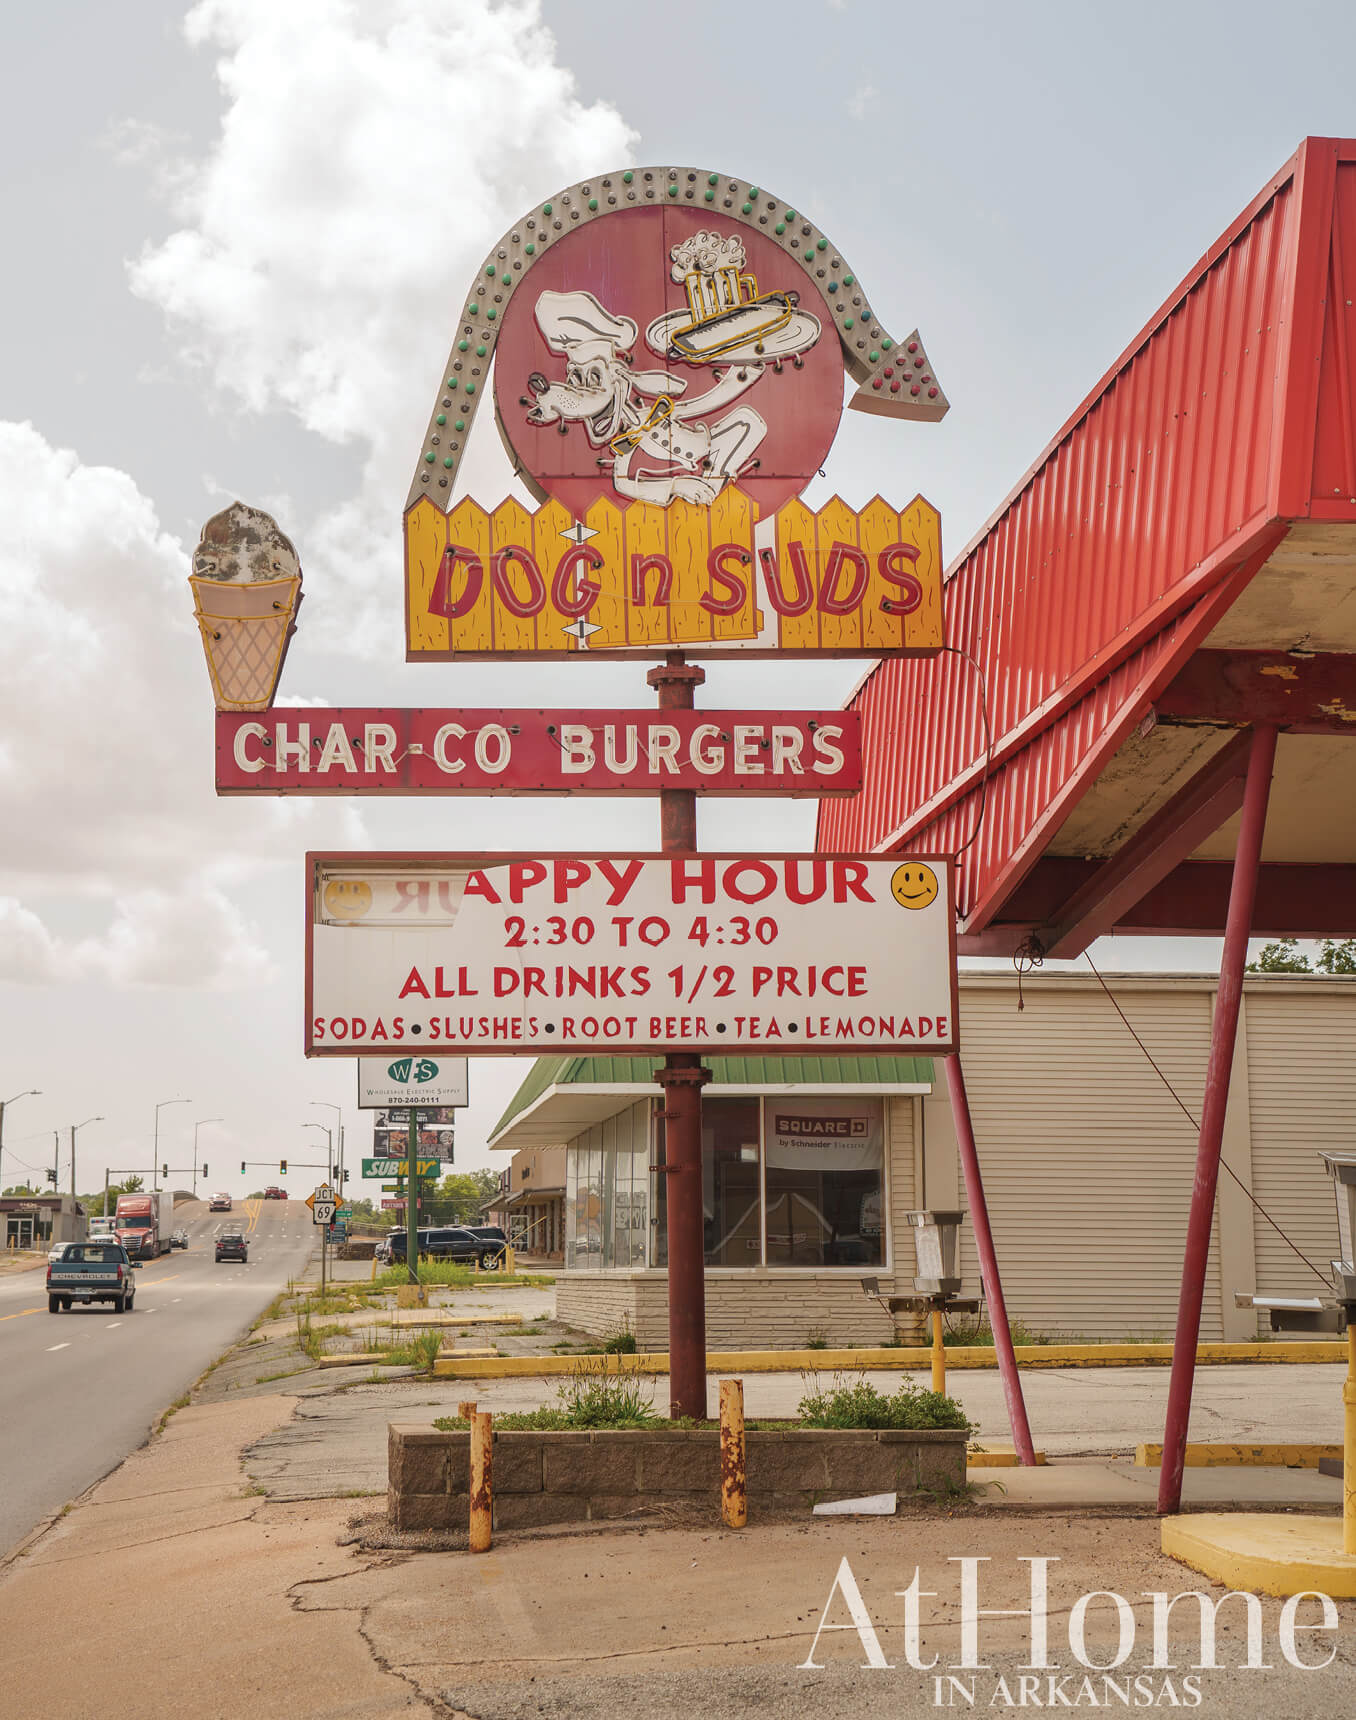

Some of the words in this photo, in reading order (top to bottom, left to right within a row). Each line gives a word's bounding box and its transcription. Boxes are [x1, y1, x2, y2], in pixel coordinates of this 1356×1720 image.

[428, 541, 605, 618] DOG
[700, 541, 922, 617] SUDS
[233, 723, 512, 774] CHAR-CO
[561, 723, 845, 775] BURGERS
[671, 860, 876, 905] HOUR
[504, 915, 595, 947] 2:30
[611, 916, 671, 947] TO
[688, 916, 778, 947] 4:30
[398, 965, 479, 999] ALL
[494, 965, 651, 999] DRINKS
[668, 965, 736, 1003] 1/2
[753, 965, 868, 997] PRICE
[313, 1017, 405, 1041] SODAS
[429, 1017, 539, 1040] SLUSHES
[563, 1016, 637, 1039] ROOT
[650, 1016, 709, 1039] BEER
[734, 1016, 783, 1039] TEA
[805, 1016, 948, 1039] LEMONADE
[779, 1120, 848, 1134] SQUARE
[779, 1139, 789, 1148] by
[791, 1139, 832, 1149] Schneider
[316, 1189, 333, 1200] JCT
[317, 1206, 330, 1219] 69
